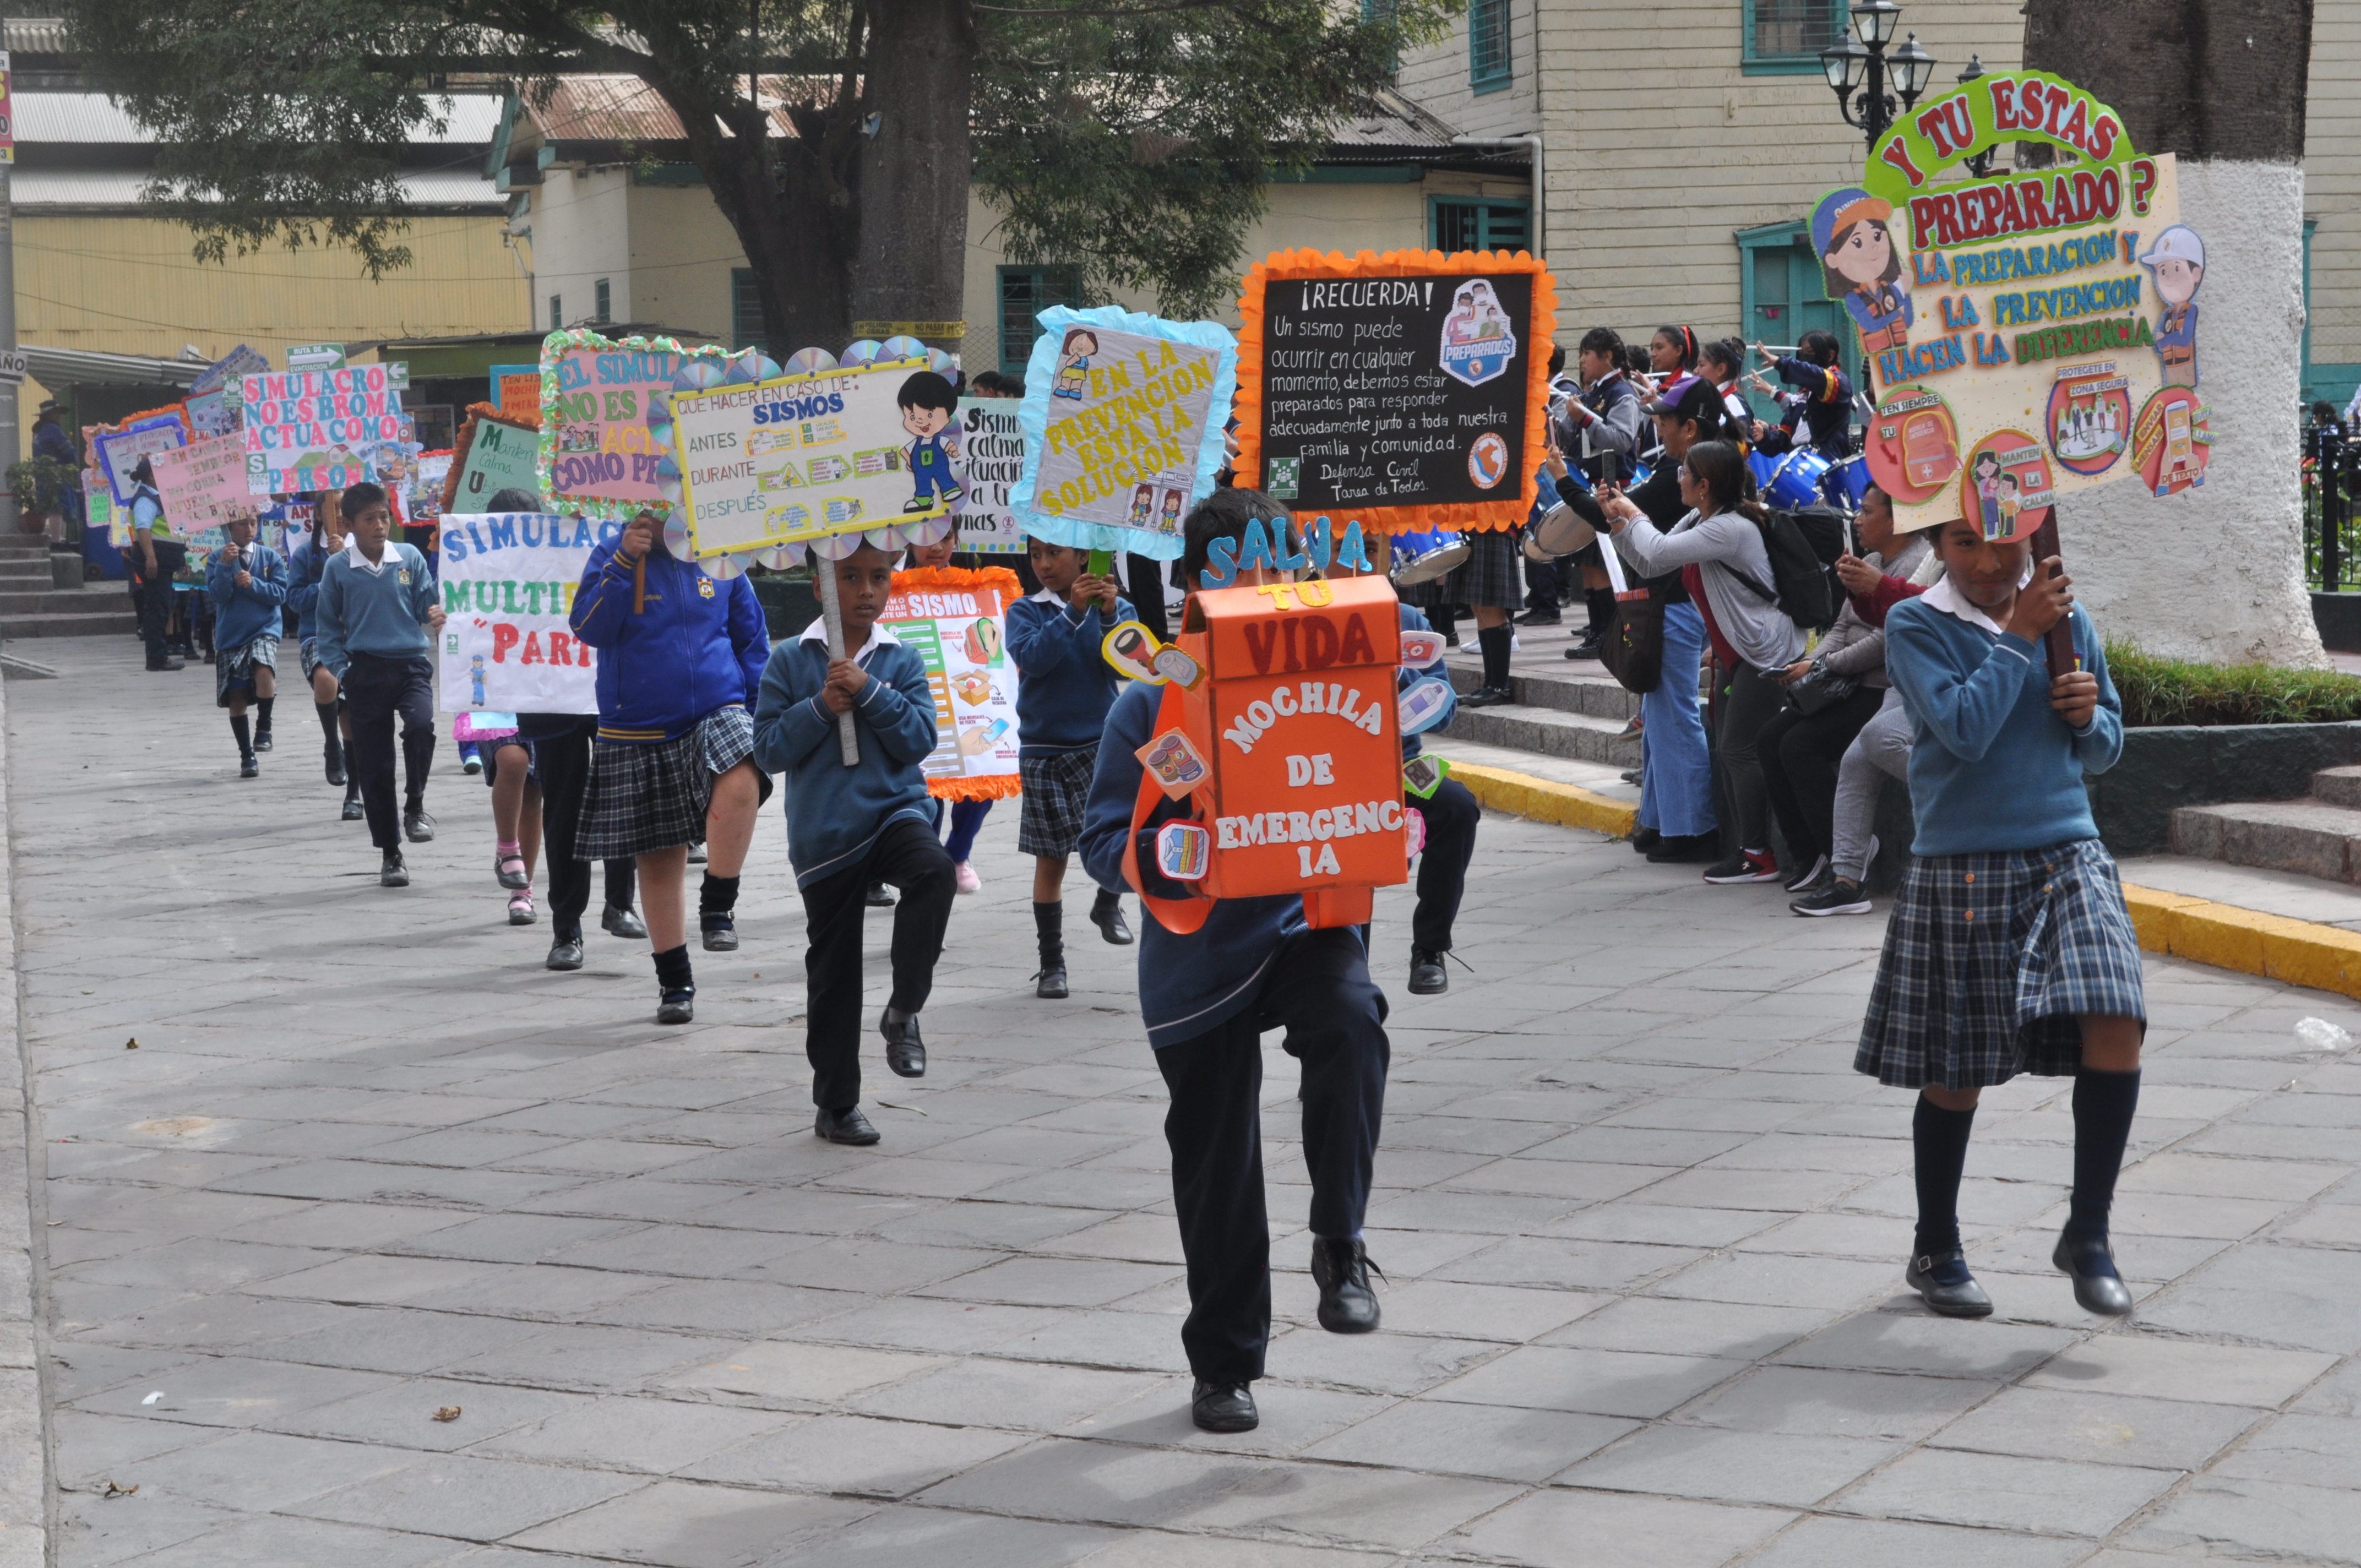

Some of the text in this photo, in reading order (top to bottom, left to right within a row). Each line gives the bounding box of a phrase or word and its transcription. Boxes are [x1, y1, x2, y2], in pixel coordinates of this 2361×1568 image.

[1883, 79, 2119, 187] Y TU ESTAS
[1910, 168, 2121, 248] PREPARADO
[1913, 230, 2139, 286] LA PREPARACION Y
[1301, 280, 1434, 312] ¡RECUERDA!
[1942, 275, 2141, 329] LA PREVENCION
[1275, 315, 1403, 346] Un sismo puede
[0, 353, 25, 372] ÑO
[1271, 345, 1416, 375] ocurrir en cualquier
[1879, 316, 2155, 385] HACEN LA DIFERENCIA
[290, 363, 328, 373] EVACUACION
[502, 375, 520, 385] TEN
[554, 357, 591, 392] EL
[1089, 340, 1179, 398] EN LA
[1271, 368, 1448, 394] momento, debemos estar
[2057, 362, 2115, 377] PROTEGETE EN
[244, 367, 384, 403] SIMULACRO
[388, 381, 409, 390] SALIDA
[677, 397, 707, 416] QUE
[710, 390, 759, 411] HACER
[762, 386, 782, 404] EN
[786, 379, 824, 400] CASO
[2071, 378, 2129, 395] ZONA SEGURA
[243, 391, 402, 427] NO ES BROMA
[559, 391, 598, 424] NO
[603, 390, 637, 421] ES
[753, 392, 845, 425] SISMOS
[1044, 357, 1214, 455] PREVENCION
[1271, 391, 1449, 421] preparados para responder
[1882, 394, 1940, 415] TEN SIEMPRE
[2139, 402, 2163, 439] ENVIAR
[246, 416, 398, 451] ACTUA COMO
[1076, 403, 1193, 473] ESTA LA
[1269, 405, 1508, 438] adecuadamente junto a toda nuestra
[1883, 427, 1895, 437] TU
[480, 424, 534, 464] Manten
[689, 431, 737, 454] ANTES
[1359, 444, 1368, 462] y
[2001, 448, 2039, 464] MANTEN
[2135, 429, 2164, 467] MENSAJE
[268, 461, 379, 493] PERSONA
[479, 453, 514, 475] Calma
[551, 452, 625, 492] COMO
[691, 460, 757, 486] DURANTE
[1041, 436, 1185, 516] SOLUCION
[1320, 458, 1419, 481] Defensa Civil
[2027, 475, 2038, 484] LA
[2162, 467, 2199, 483] DE TEXTO
[695, 489, 767, 520] DESPUÉS
[1331, 484, 1370, 502] Tarea
[1375, 482, 1389, 496] de
[2023, 494, 2055, 508] CALMA
[1200, 515, 1373, 590] SALVA
[1257, 580, 1334, 610] TU
[1243, 612, 1375, 676] VIDA
[1223, 682, 1382, 754] MOCHILA
[1286, 753, 1335, 787] DE
[1215, 799, 1404, 850] EMERGENC
[1297, 843, 1341, 878] IA
